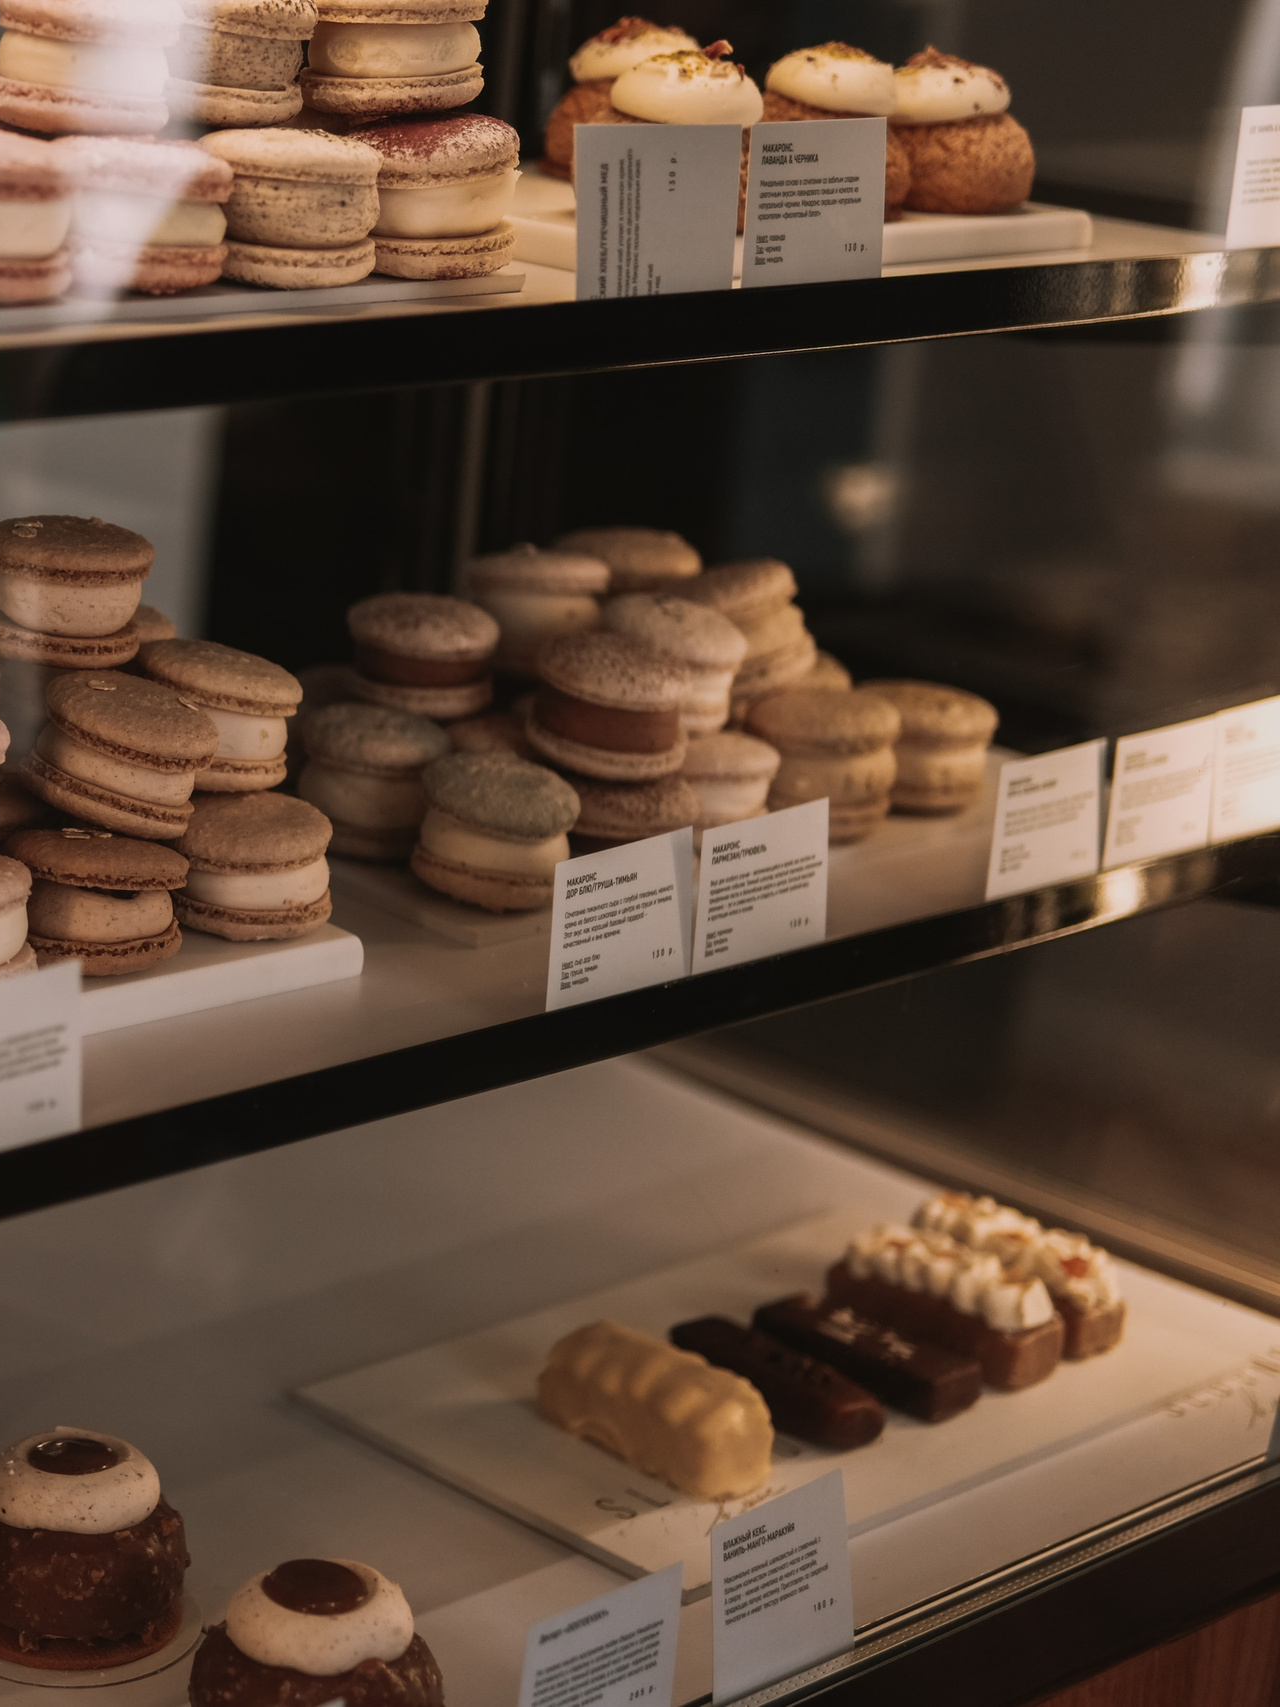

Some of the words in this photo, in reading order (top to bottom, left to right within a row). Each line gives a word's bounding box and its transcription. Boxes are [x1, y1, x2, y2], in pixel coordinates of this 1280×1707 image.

[761, 155, 788, 165] ЛАВАНДА
[794, 153, 819, 164] ЧЕРНИКА
[600, 163, 609, 184] МЕД
[668, 171, 676, 192] 130
[599, 186, 608, 273] ХЛЕБ/ГРЕЧИШНЫЙ
[844, 242, 857, 252] 130
[711, 844, 767, 865] ПАРМЕЗАН/ТРЮФЕЛЬ
[712, 840, 741, 855] МАКАРОНС
[565, 888, 578, 900] ДОР
[579, 872, 638, 895] БЛЮ/ГРУША-ТИМЬЯН
[566, 872, 597, 888] МАКАРОНС
[652, 948, 665, 959] 130
[723, 1529, 751, 1551] ВЛАЖНЫЙ
[723, 1522, 795, 1562] ВАНИЛЬ-МАНГО-МАРАКУЙЯ
[813, 1599, 826, 1612] 180
